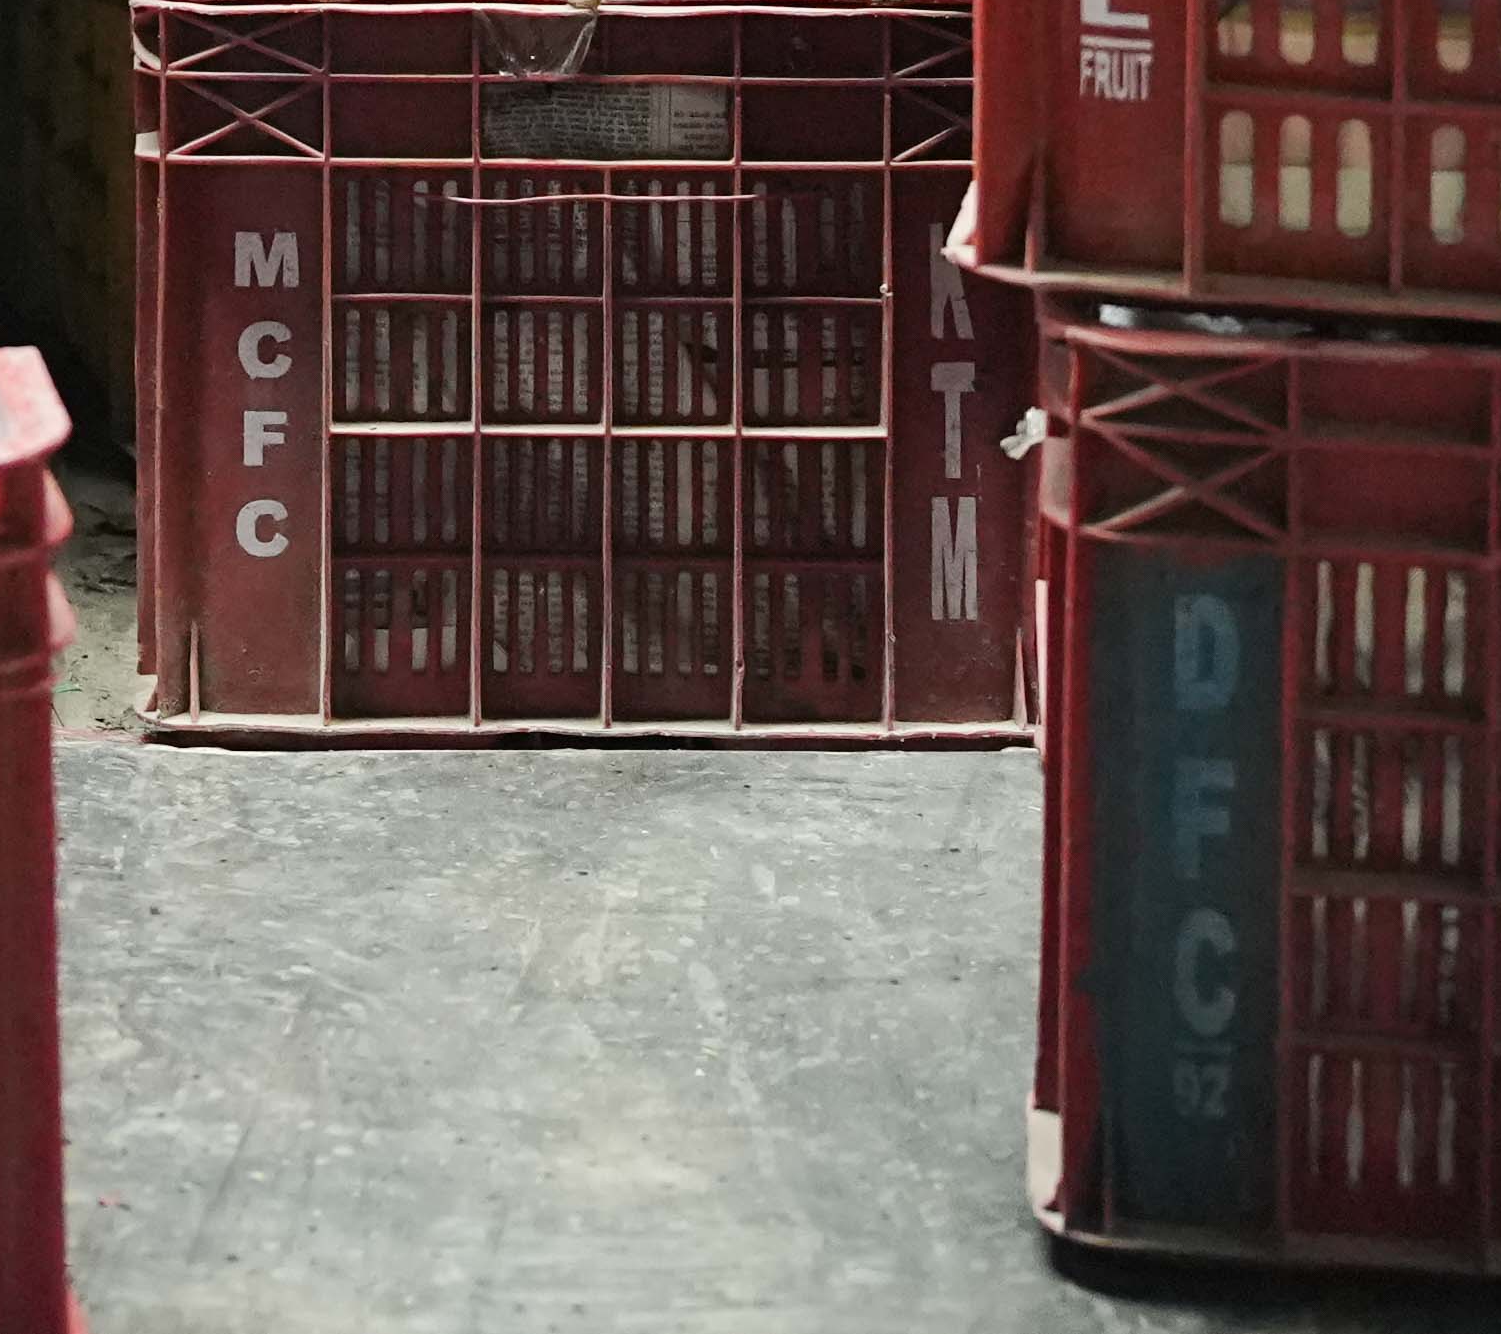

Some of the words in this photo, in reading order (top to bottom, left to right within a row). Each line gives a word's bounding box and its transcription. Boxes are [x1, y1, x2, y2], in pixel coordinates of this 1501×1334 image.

[1080, 49, 1153, 101] FRUIT
[235, 230, 299, 559] MCFC
[928, 223, 978, 621] KTM
[1173, 593, 1241, 1035] DFC
